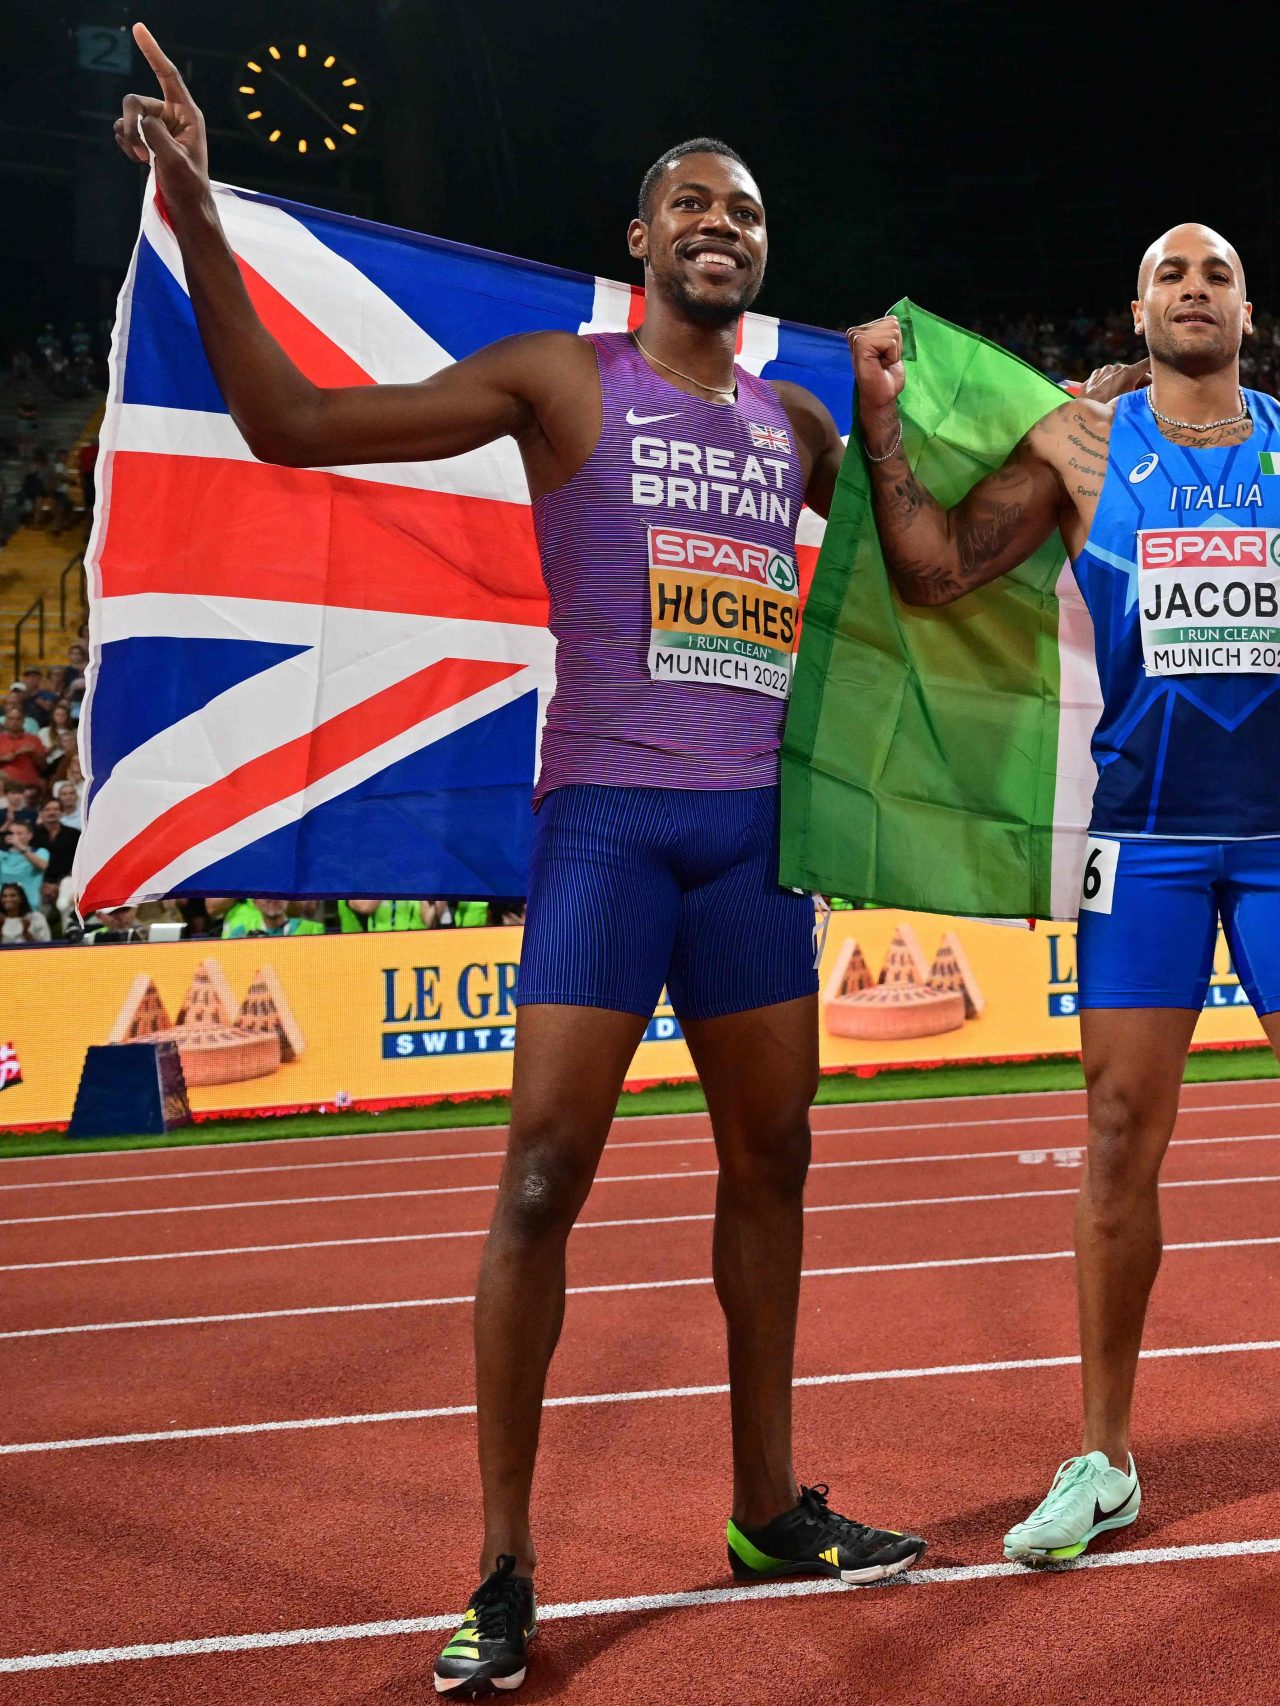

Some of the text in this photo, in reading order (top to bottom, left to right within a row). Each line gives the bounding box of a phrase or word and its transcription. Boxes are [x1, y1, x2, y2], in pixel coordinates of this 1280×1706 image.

[90, 31, 119, 67] 2
[631, 435, 791, 490] GREAT
[631, 473, 792, 528] BRITAIN
[1169, 483, 1264, 511] ITALIA
[655, 534, 769, 579] SPAR
[1145, 536, 1264, 565] SPAR
[658, 582, 794, 643] HUGHES
[697, 636, 729, 651] RUN
[1188, 629, 1219, 641] RUN
[656, 652, 788, 693] MUNICH 2022
[1154, 647, 1241, 669] MUNICH
[1083, 848, 1102, 900] 6
[381, 966, 442, 1024] LE
